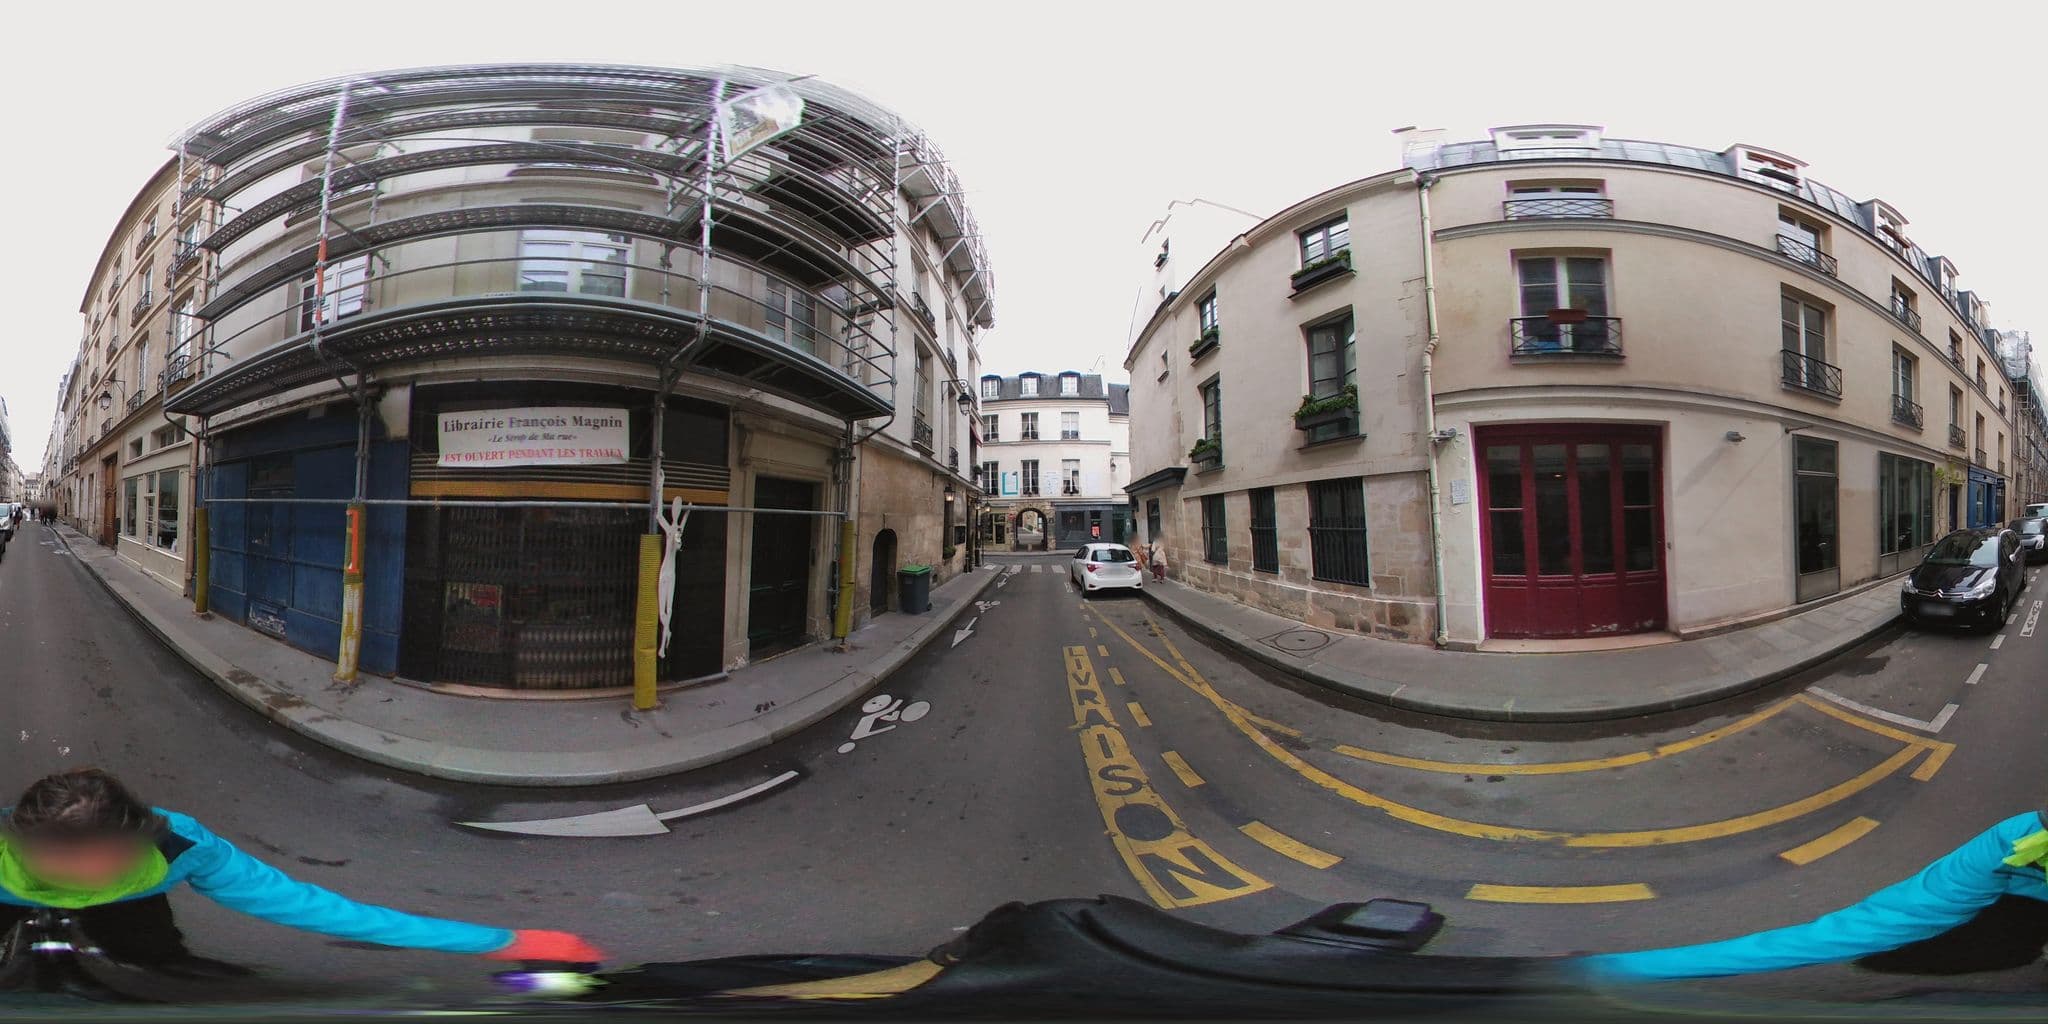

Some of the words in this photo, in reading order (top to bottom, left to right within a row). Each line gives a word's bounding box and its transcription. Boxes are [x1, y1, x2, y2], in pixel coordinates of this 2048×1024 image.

[444, 417, 504, 432] Librairie
[509, 415, 567, 429] François
[572, 415, 623, 430] Magnin
[528, 433, 539, 441] de
[444, 453, 461, 462] EST
[465, 450, 504, 461] OUVERT
[508, 448, 554, 459] PENDANT
[557, 448, 576, 458] LES
[579, 448, 624, 459] TRAVAUX
[1067, 647, 1252, 902] LIVRAISON
